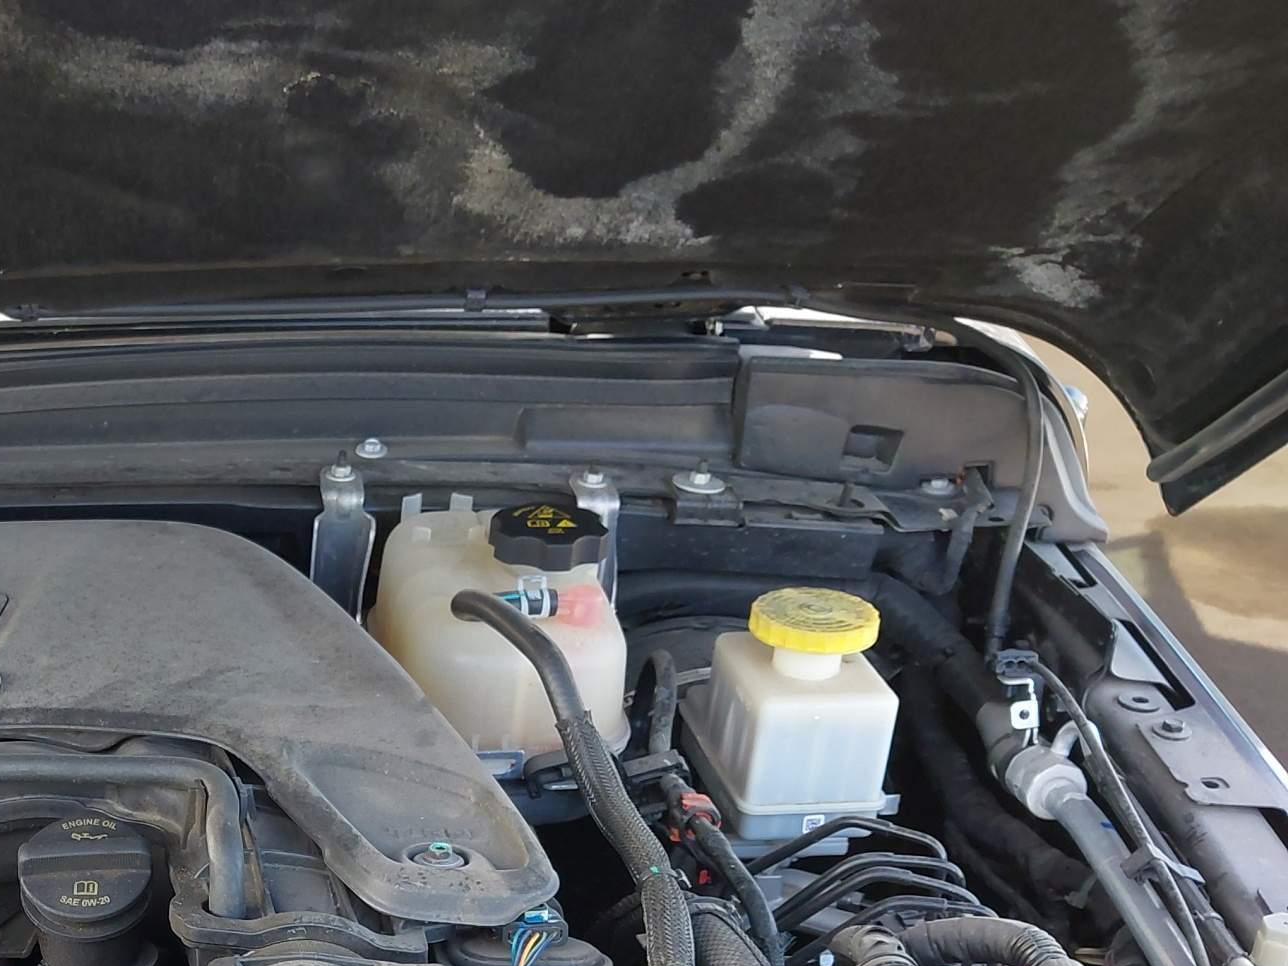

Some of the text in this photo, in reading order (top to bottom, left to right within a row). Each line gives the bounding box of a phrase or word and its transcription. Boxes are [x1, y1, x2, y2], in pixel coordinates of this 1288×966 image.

[61, 818, 117, 831] ENGINE OIL
[59, 895, 111, 908] SAE 0W-20
